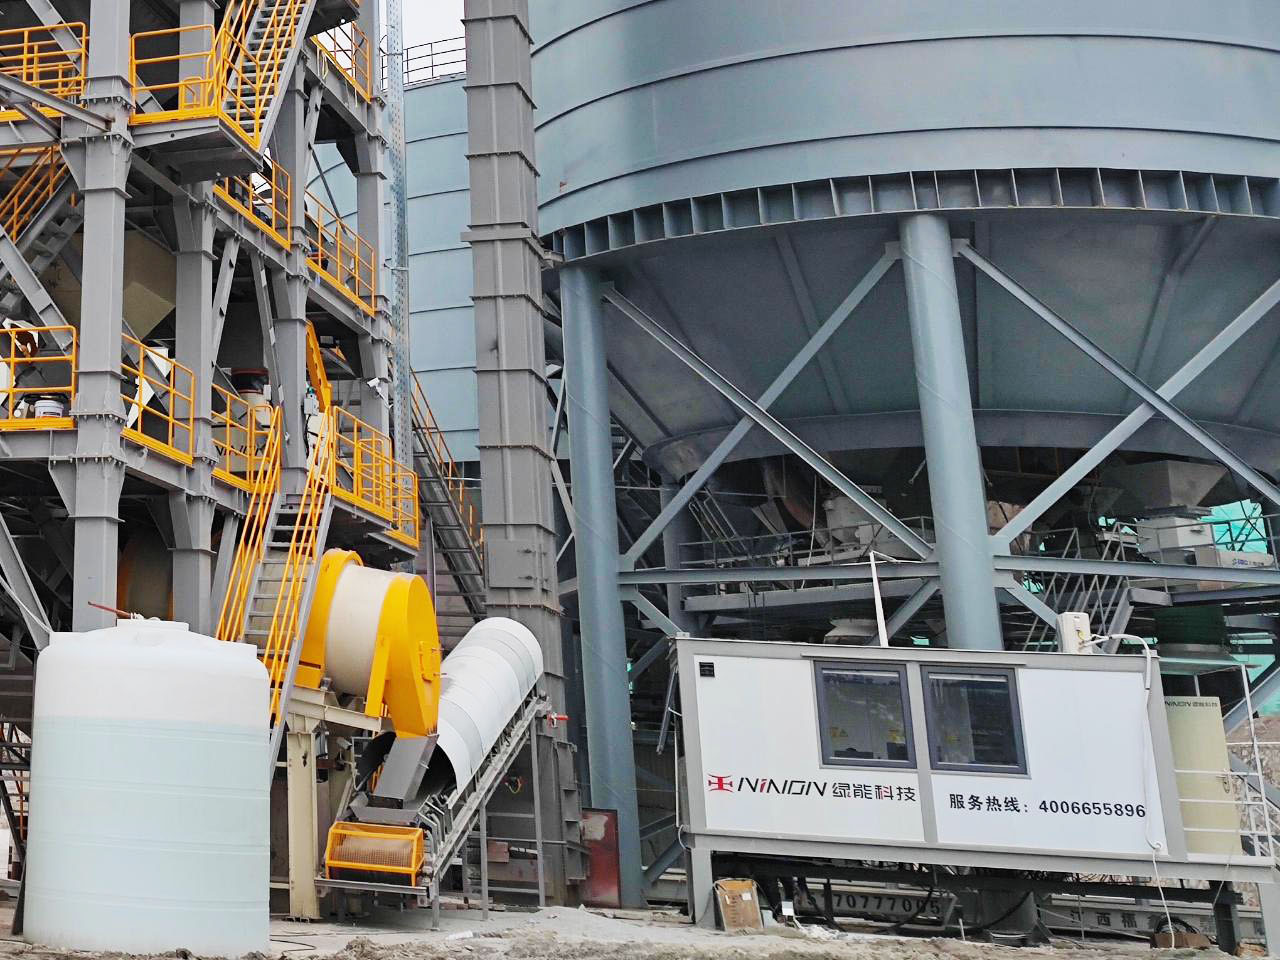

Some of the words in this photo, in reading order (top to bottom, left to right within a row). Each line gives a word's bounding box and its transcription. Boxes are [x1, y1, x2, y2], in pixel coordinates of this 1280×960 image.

[832, 782, 917, 802] 绿能科技
[1039, 800, 1146, 817] 4006655896
